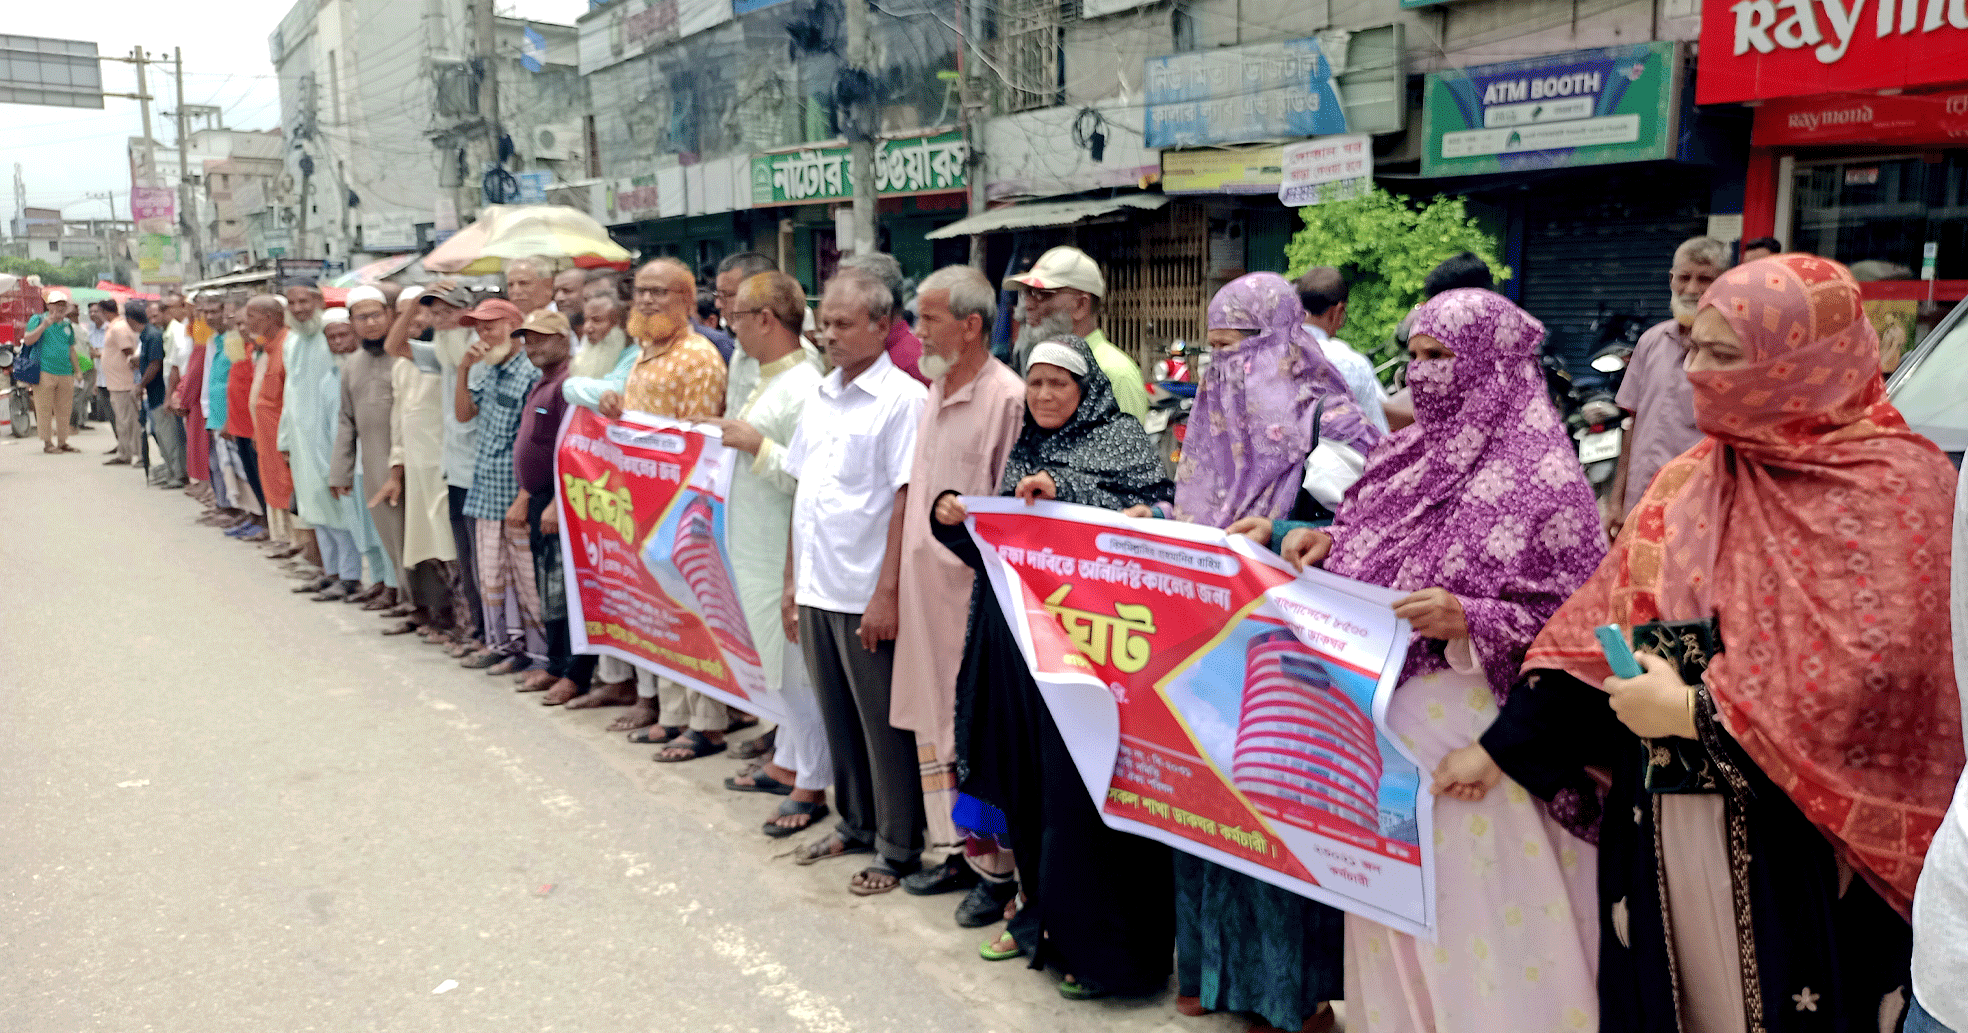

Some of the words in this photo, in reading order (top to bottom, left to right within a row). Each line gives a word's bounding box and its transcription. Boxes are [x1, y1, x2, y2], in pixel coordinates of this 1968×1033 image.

[1483, 79, 1526, 105] ATM
[1531, 71, 1602, 99] BOOTH
[1787, 105, 1874, 131] Raymond
[771, 149, 843, 201] নাটোর
[1026, 547, 1076, 577] দাবিতে
[1196, 582, 1232, 612] জন্য
